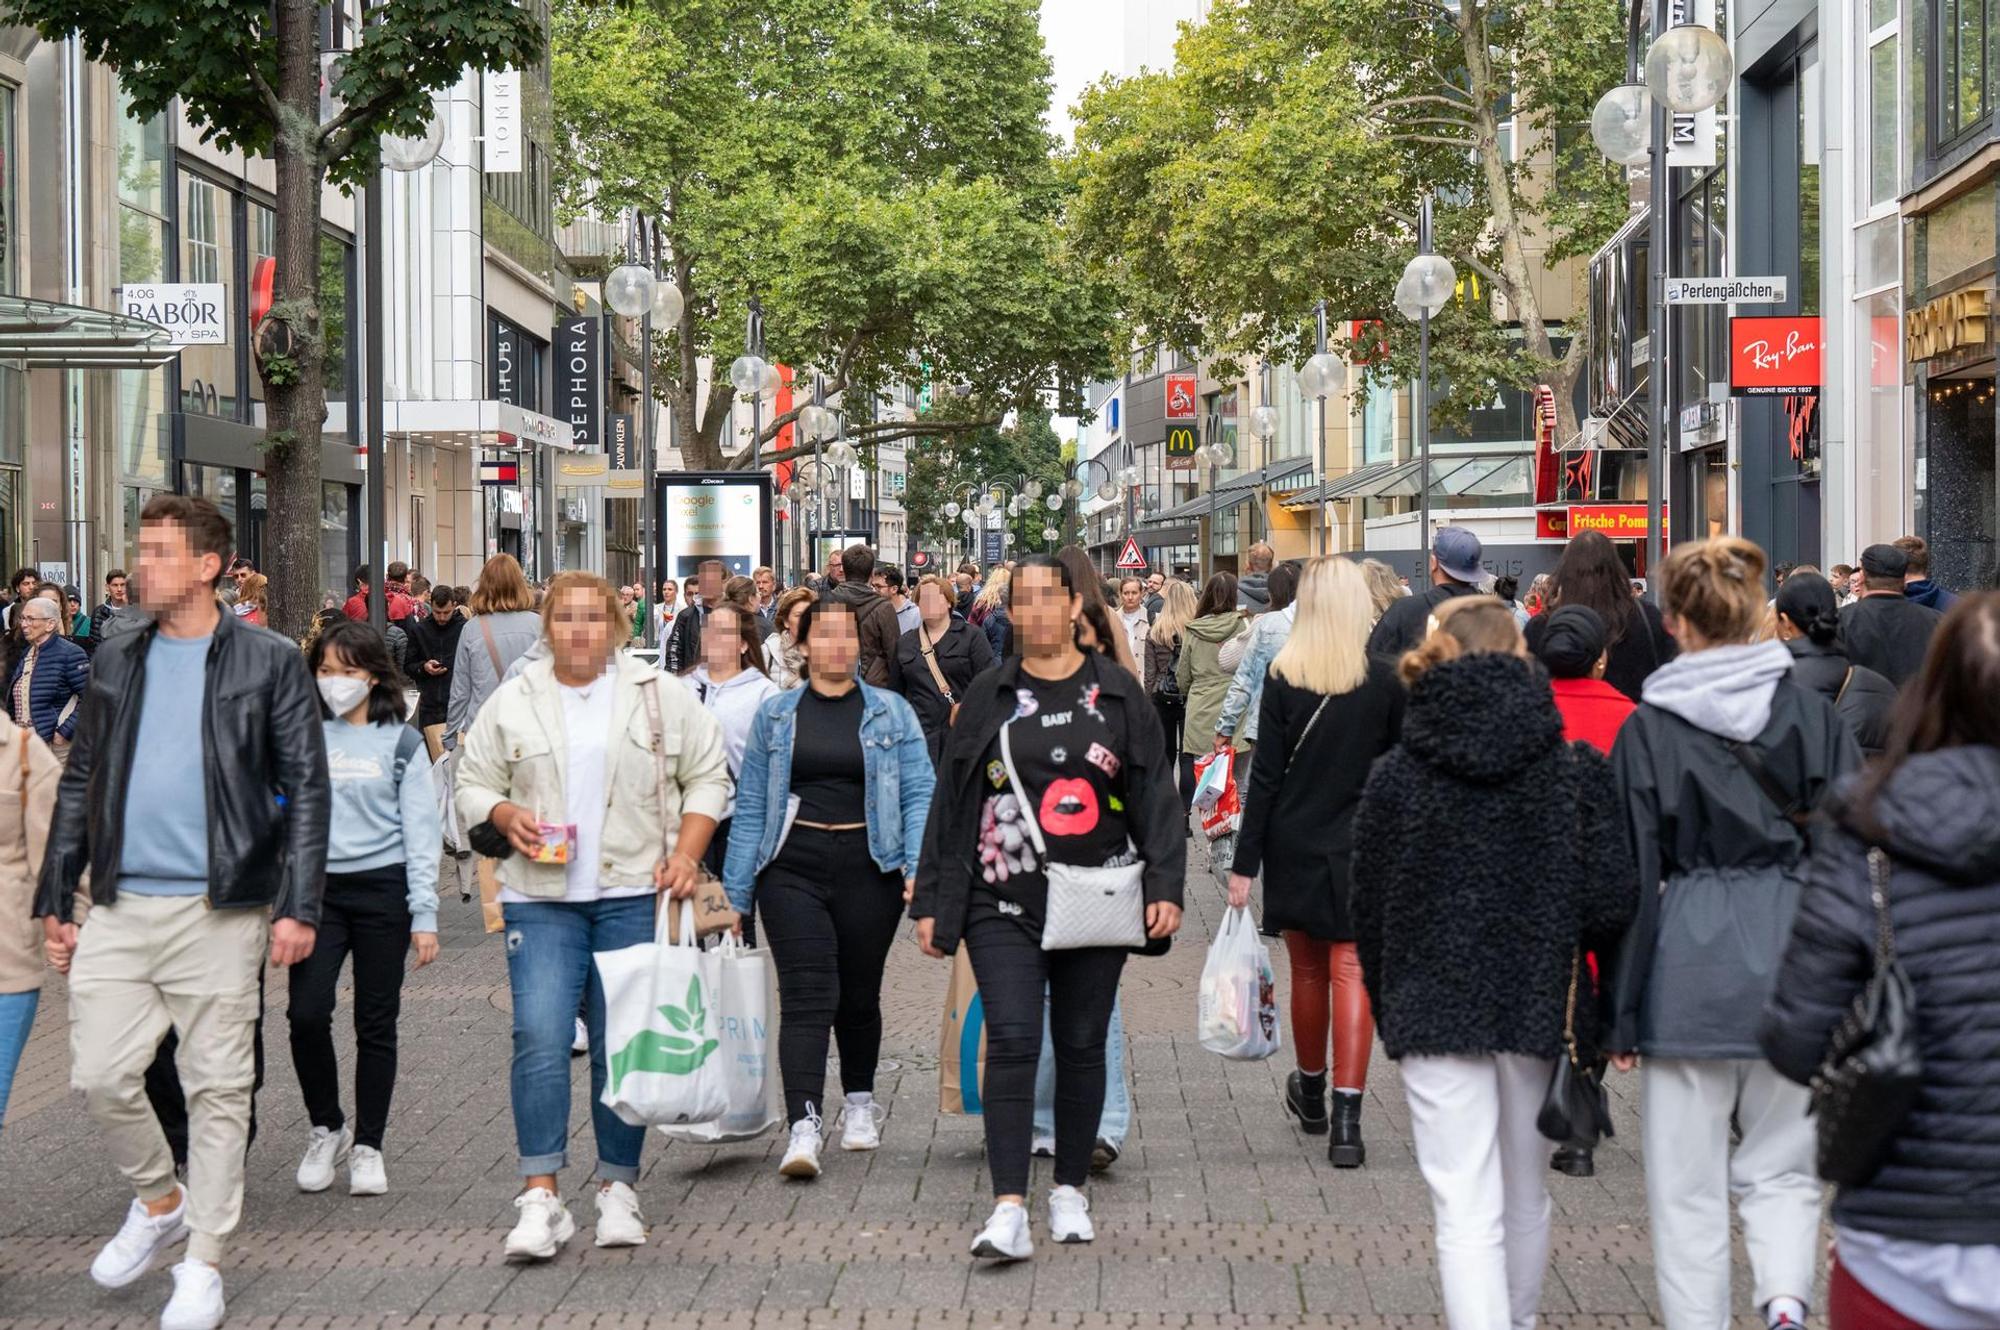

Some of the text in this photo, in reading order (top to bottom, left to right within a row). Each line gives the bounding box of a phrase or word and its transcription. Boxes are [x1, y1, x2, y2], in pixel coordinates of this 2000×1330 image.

[1681, 282, 1773, 302] Perlengäßchen
[127, 303, 219, 326] BABOR
[191, 330, 219, 339] SPA
[1743, 330, 1816, 370] Ray-Ban
[570, 321, 588, 440] SEPHORA
[1574, 513, 1615, 528] Frische
[1041, 711, 1073, 728] BABY
